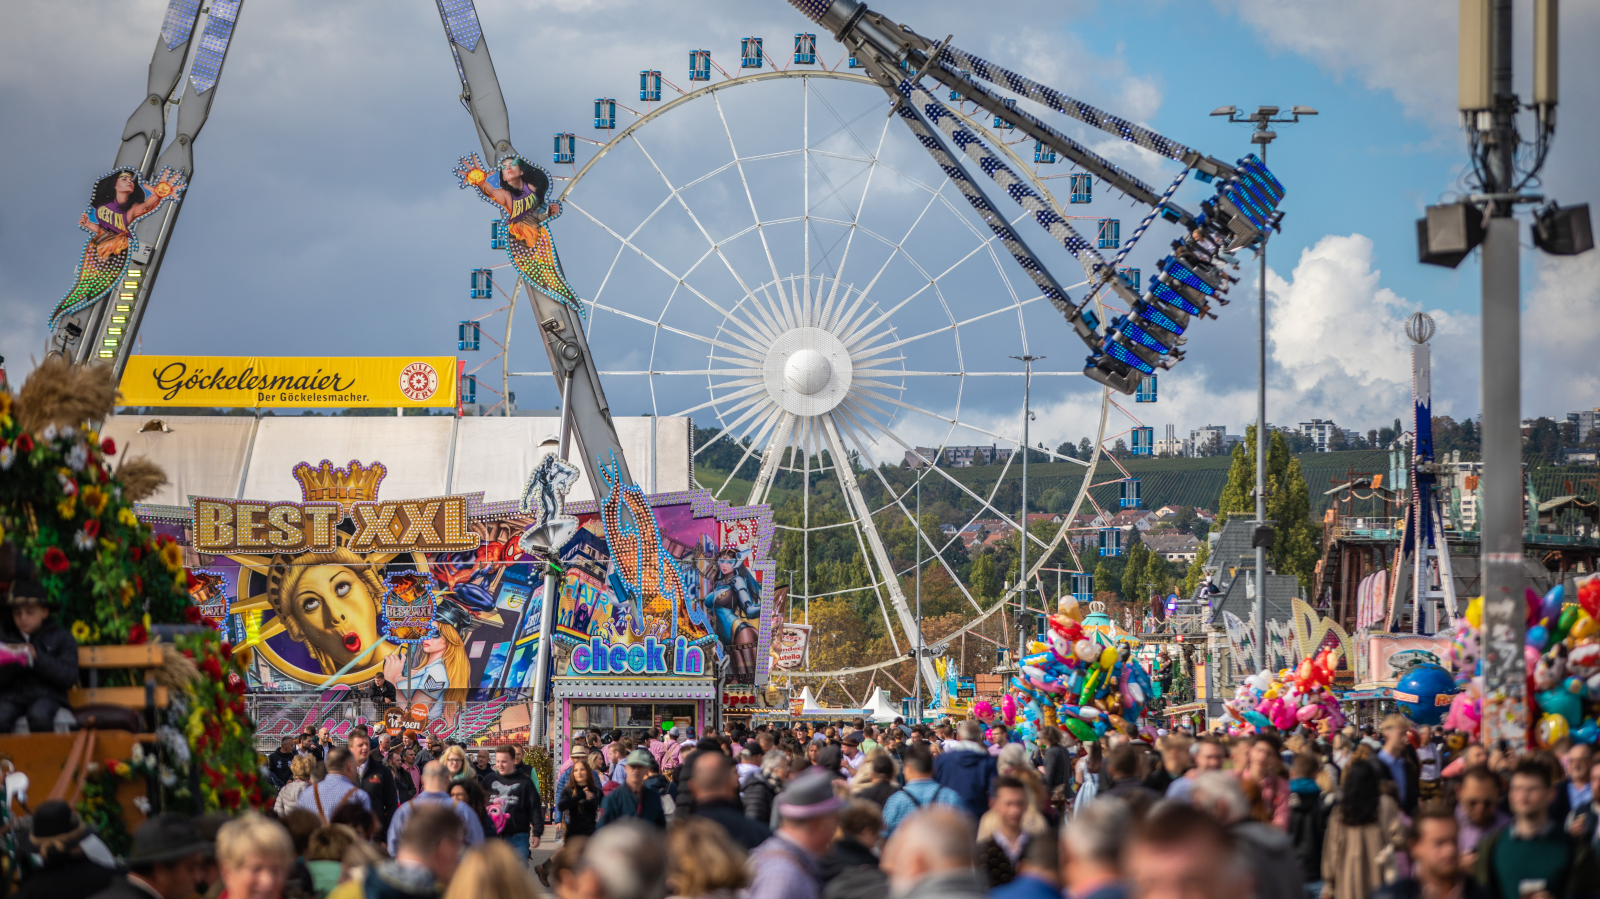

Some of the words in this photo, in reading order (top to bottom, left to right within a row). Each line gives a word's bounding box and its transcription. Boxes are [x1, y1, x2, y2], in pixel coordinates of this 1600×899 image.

[97, 205, 114, 225] BEST
[153, 362, 356, 401] Göckelesmaier
[258, 392, 276, 402] Der
[280, 392, 370, 402] Göckelesmacher.
[310, 486, 364, 500] THE
[199, 501, 338, 547] BEST
[355, 500, 474, 546] XXL
[562, 578, 610, 614] HAIR
[385, 605, 410, 618] BEST
[572, 637, 667, 673] check
[674, 637, 703, 674] in
[779, 653, 801, 661] utella
[722, 692, 756, 707] êpes
